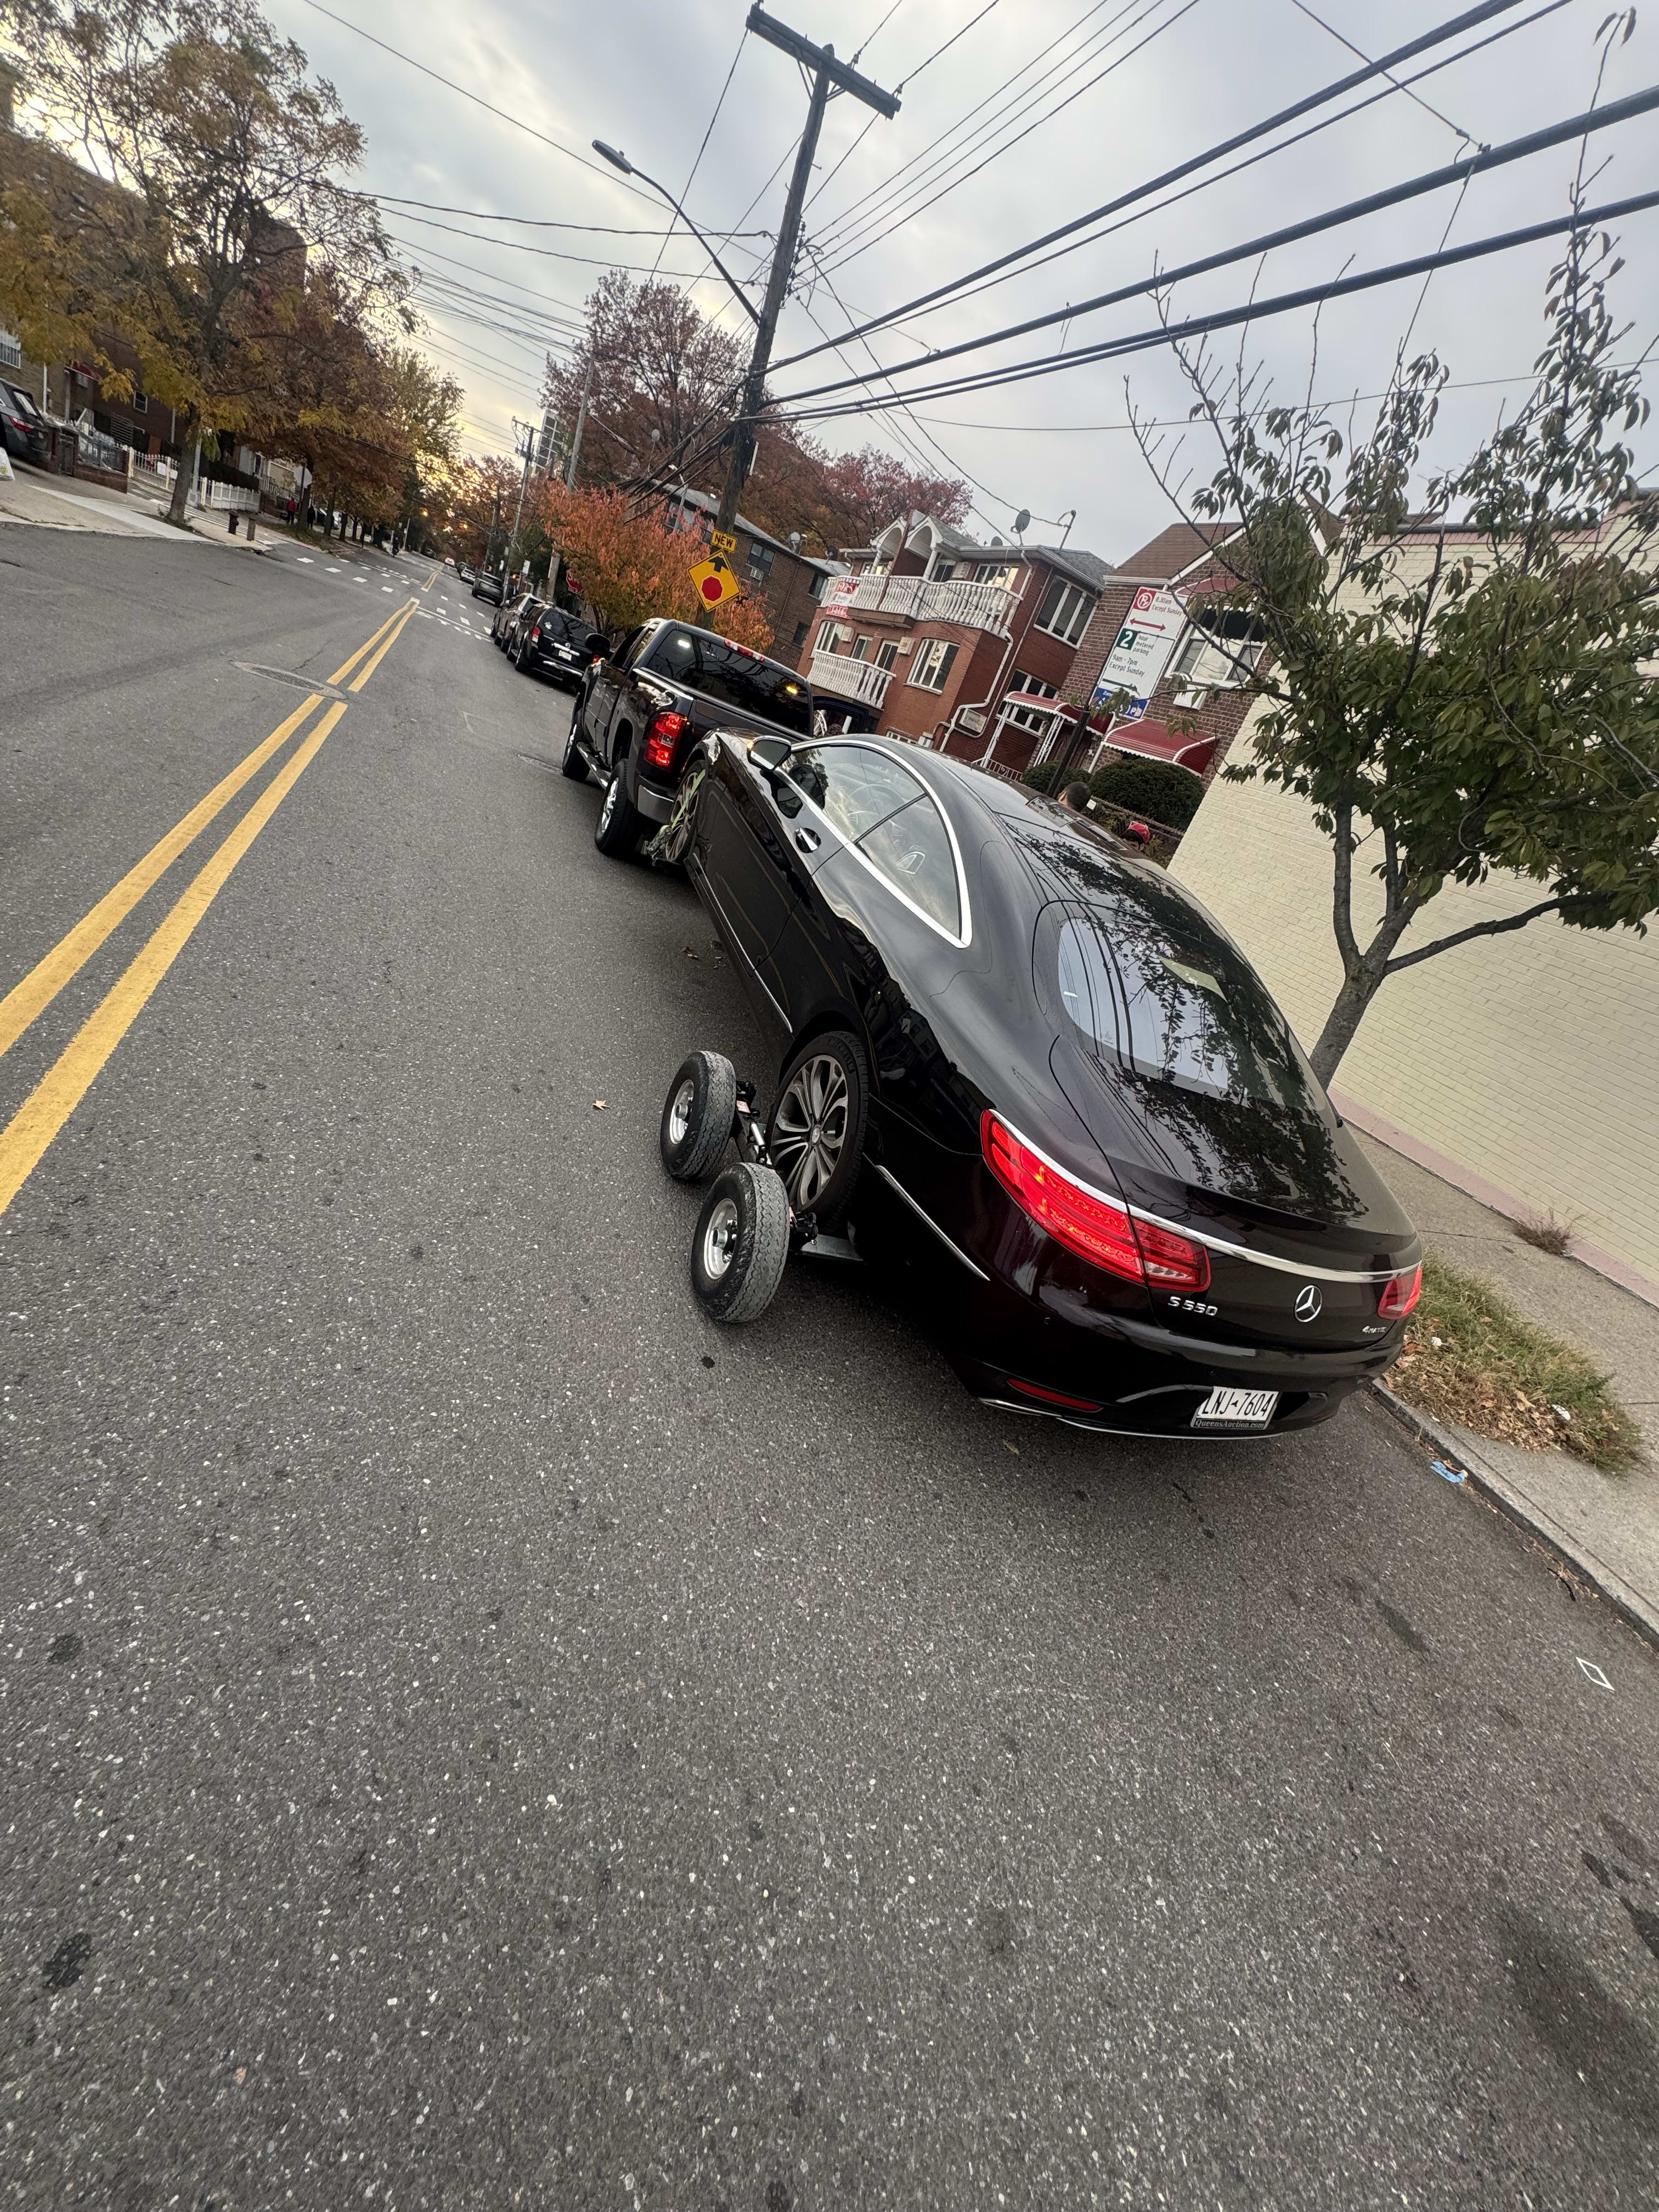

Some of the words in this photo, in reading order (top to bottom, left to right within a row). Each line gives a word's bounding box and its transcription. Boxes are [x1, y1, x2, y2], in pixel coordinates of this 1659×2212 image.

[714, 533, 733, 548] NEW
[1152, 604, 1166, 612] Except
[1120, 631, 1133, 647] 2
[1136, 641, 1154, 650] metered
[1132, 647, 1149, 656] parking
[1112, 654, 1123, 662] 9am
[1127, 657, 1138, 665] 7pm
[1109, 661, 1126, 672] Except
[1126, 665, 1145, 678] Sunday
[1167, 1296, 1181, 1307] S
[1182, 1300, 1218, 1316] 550
[1362, 1325, 1387, 1334] 4MATIC
[1195, 1420, 1265, 1428] QueensAuction.com
